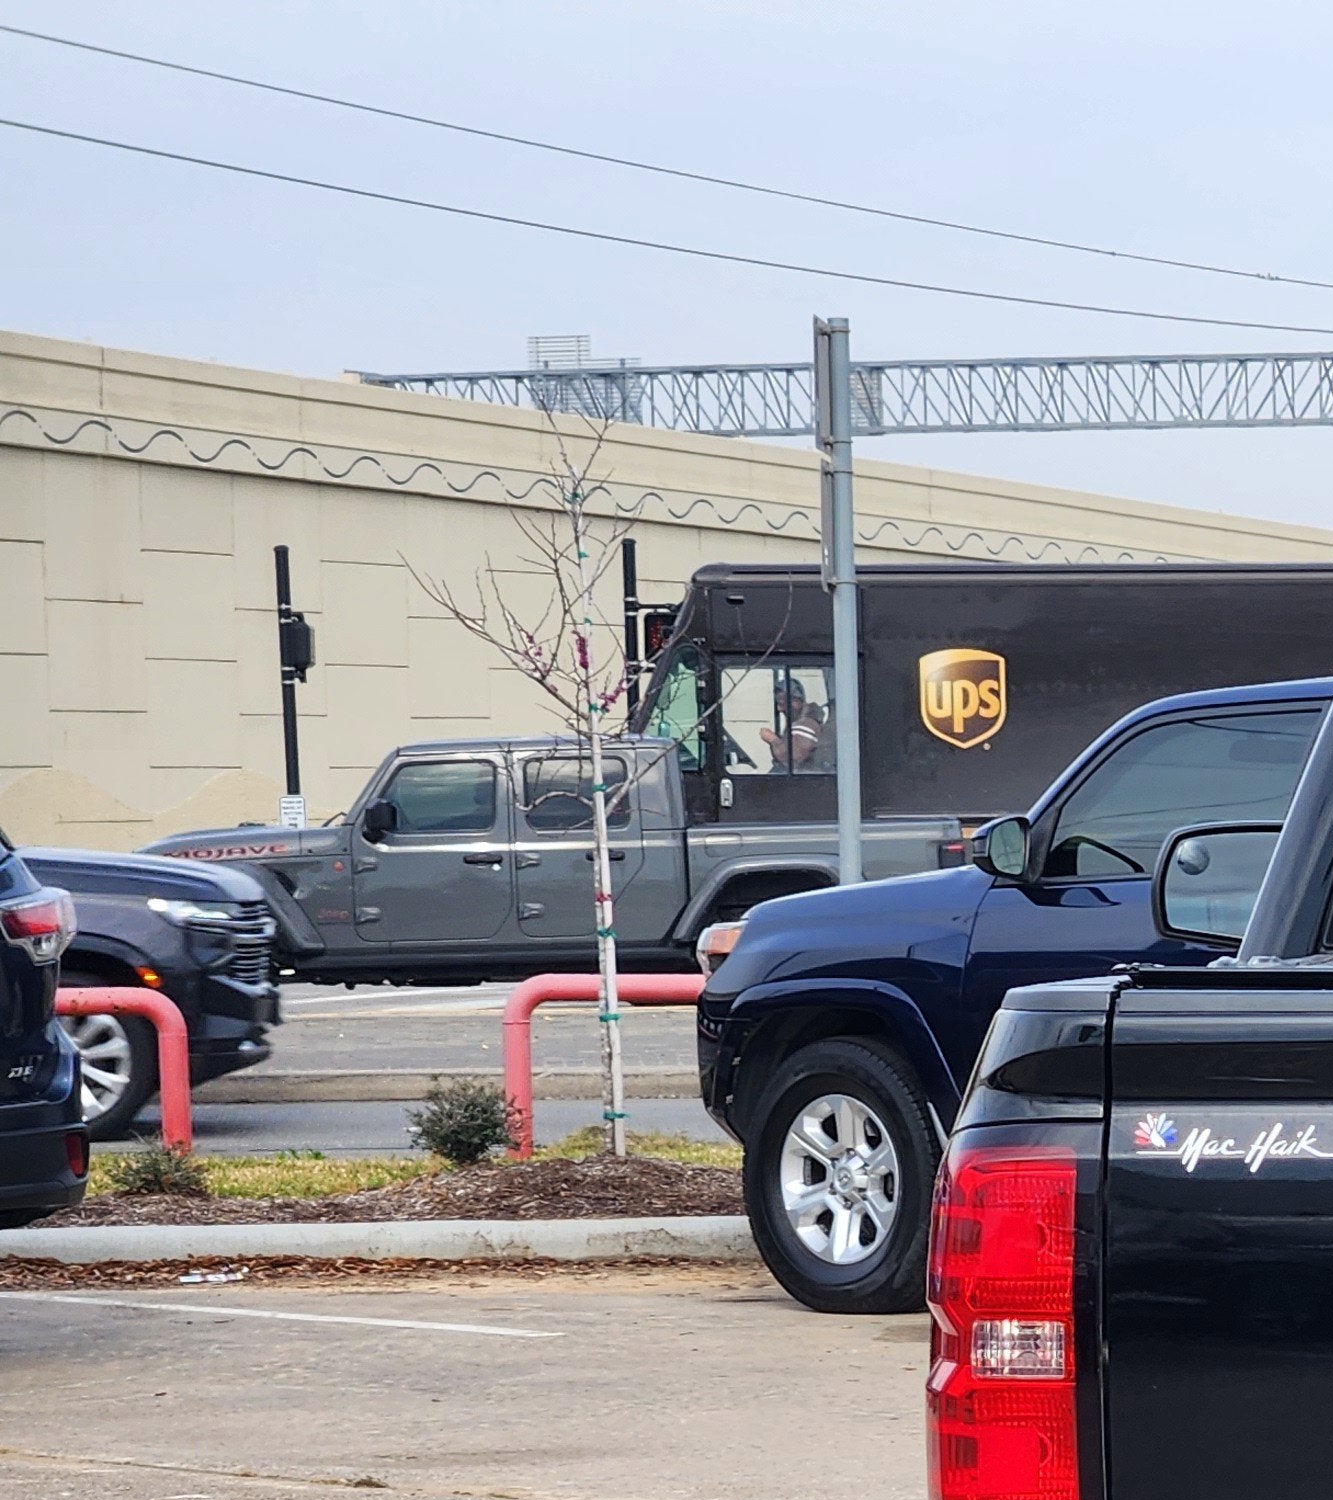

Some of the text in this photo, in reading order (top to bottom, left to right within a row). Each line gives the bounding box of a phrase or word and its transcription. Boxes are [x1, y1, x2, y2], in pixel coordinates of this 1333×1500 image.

[927, 679, 1001, 733] ups
[1177, 1122, 1318, 1173] Mac Haik
